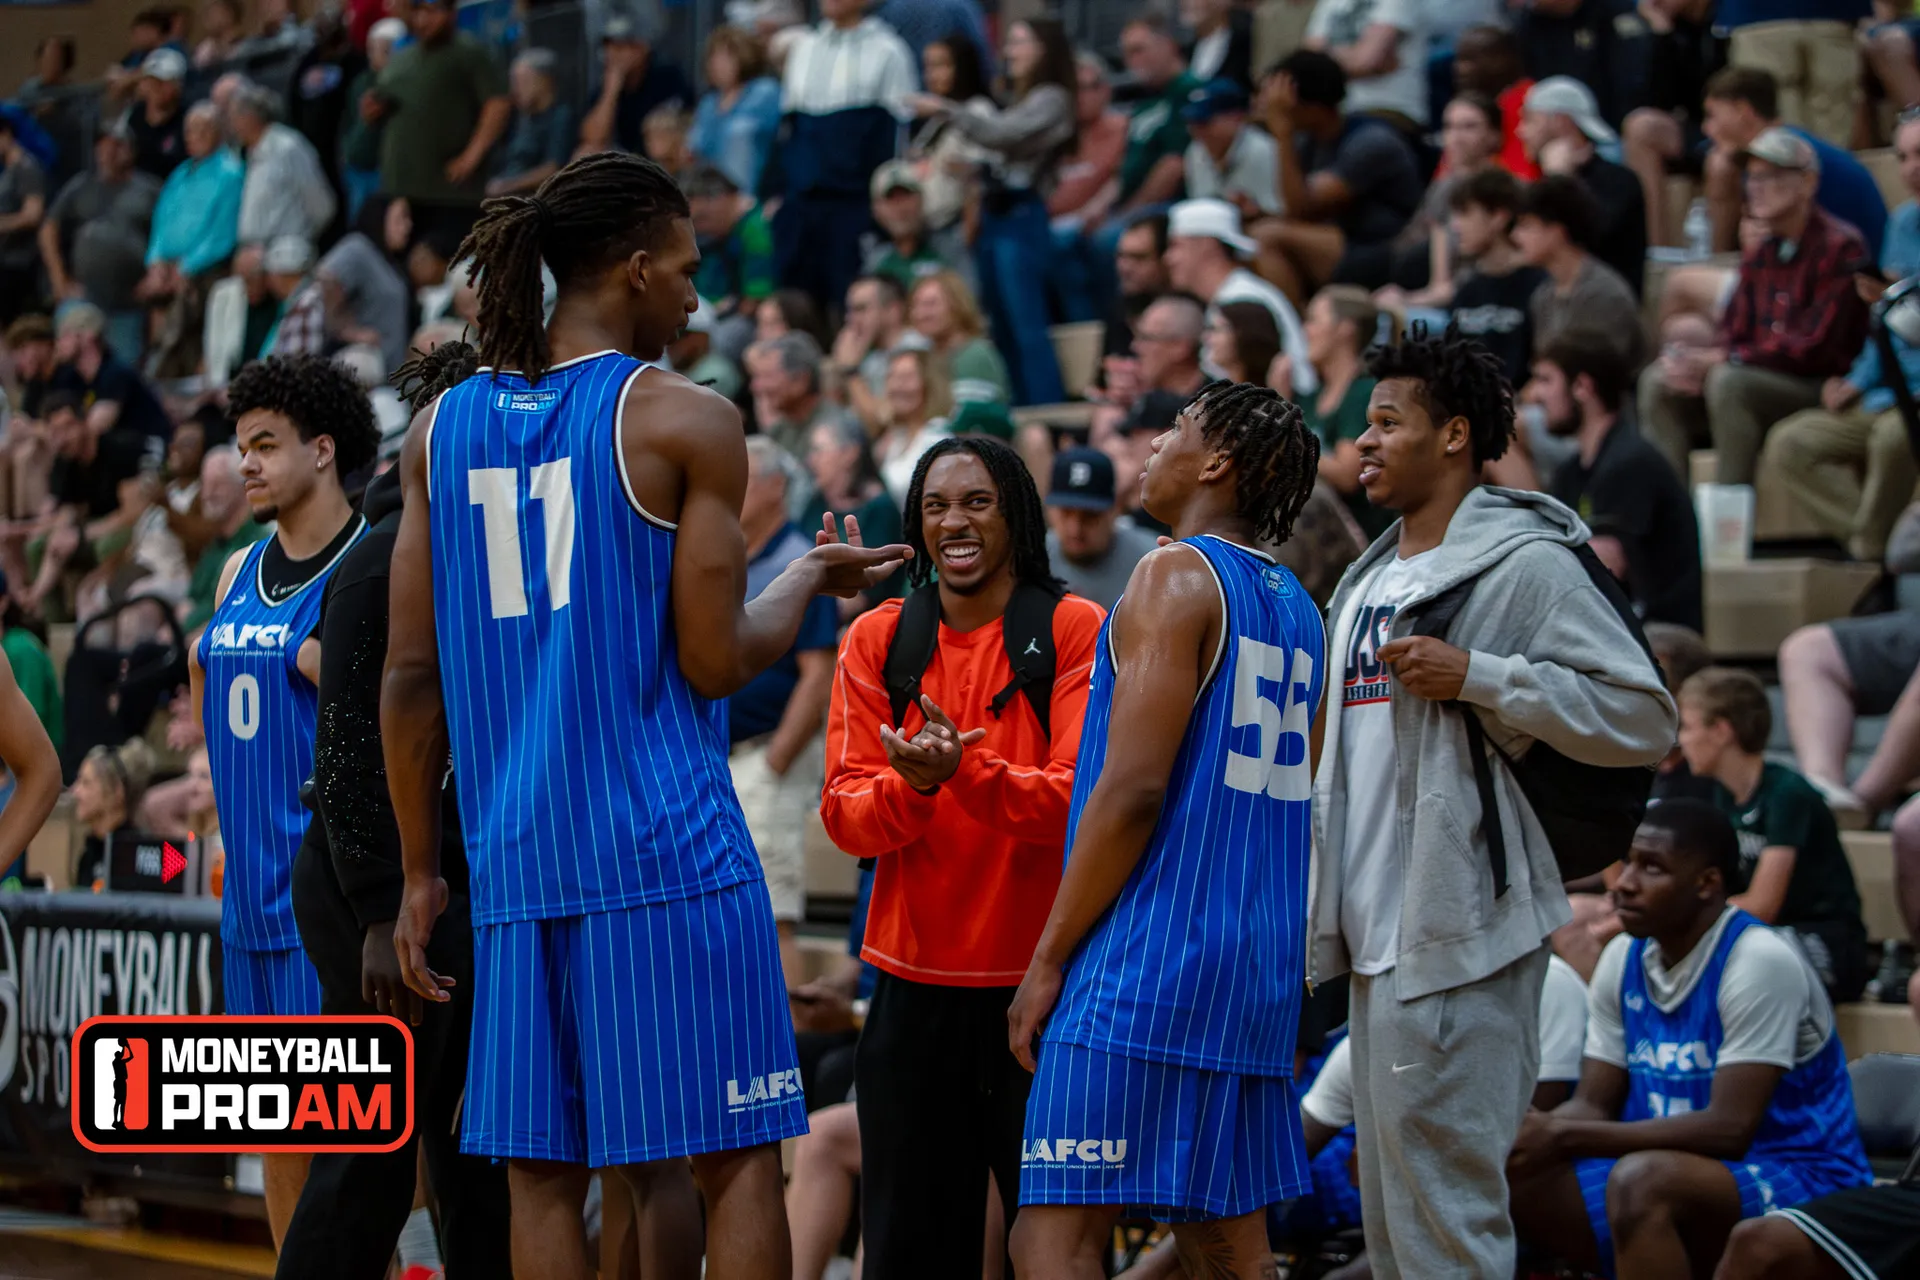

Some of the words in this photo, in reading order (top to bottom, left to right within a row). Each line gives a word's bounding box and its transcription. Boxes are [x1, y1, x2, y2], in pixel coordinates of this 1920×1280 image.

[467, 456, 575, 619] 11
[1345, 604, 1395, 685] US
[228, 672, 260, 741] 0
